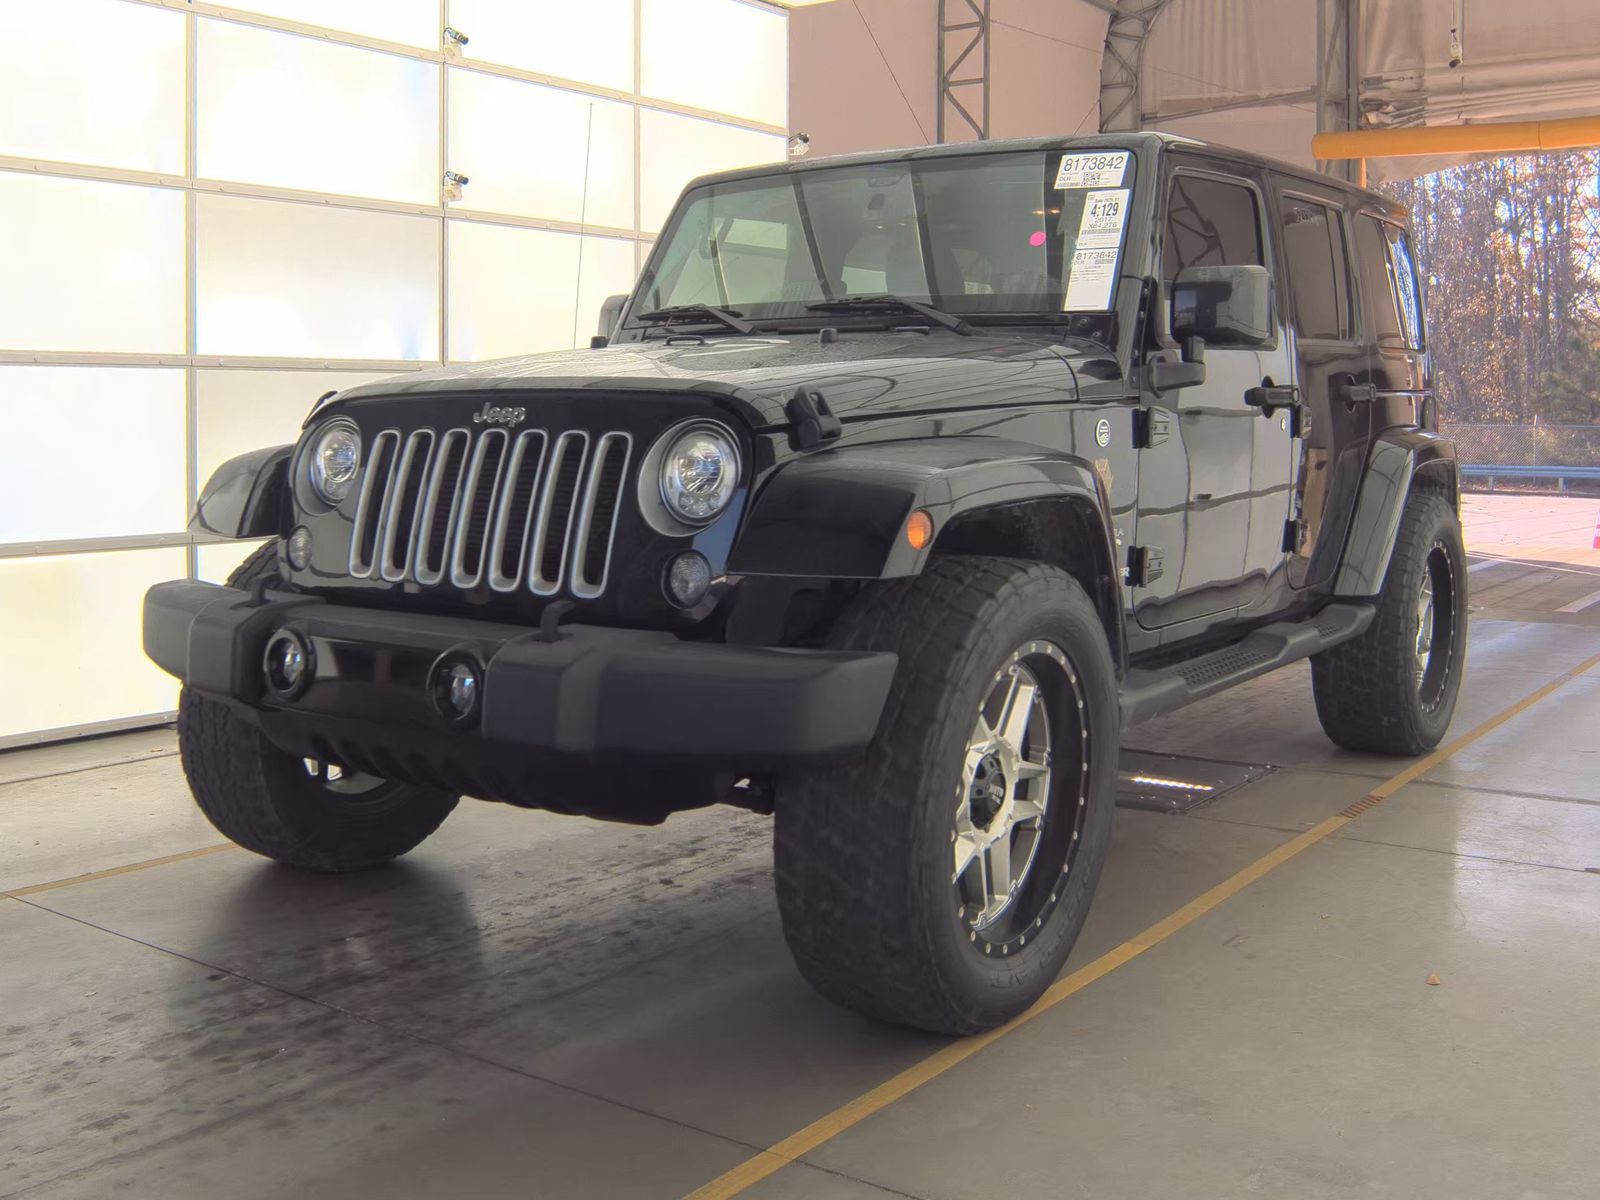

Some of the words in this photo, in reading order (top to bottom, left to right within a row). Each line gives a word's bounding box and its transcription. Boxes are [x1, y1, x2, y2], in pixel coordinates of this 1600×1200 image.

[1064, 156, 1124, 172] 8173842
[1090, 202, 1119, 217] 4:129
[1076, 250, 1117, 261] 8173842
[473, 402, 526, 428] Jeep
